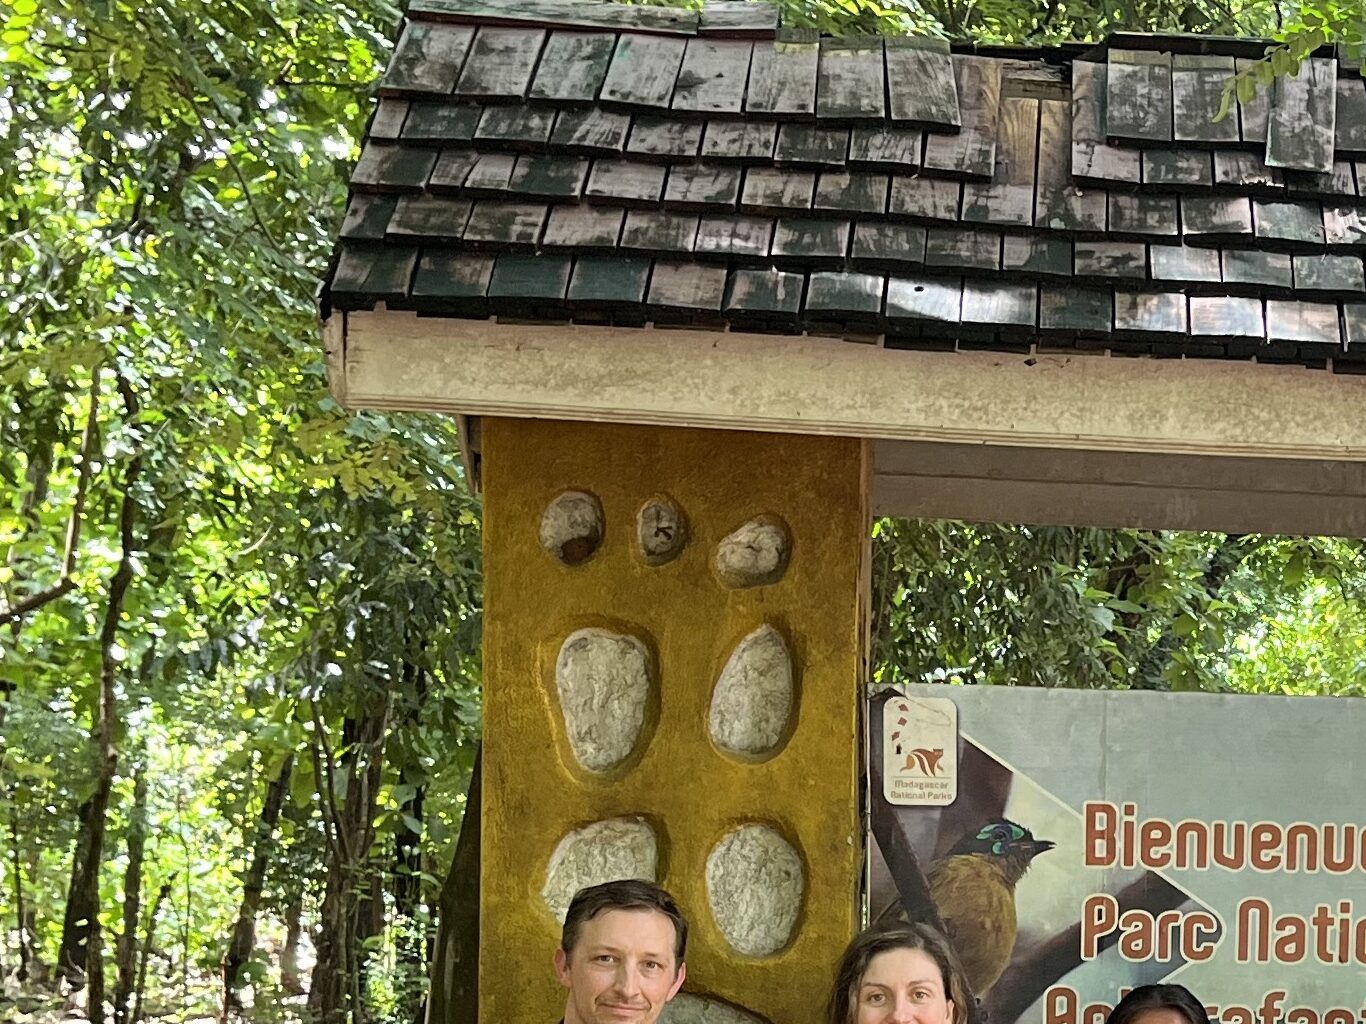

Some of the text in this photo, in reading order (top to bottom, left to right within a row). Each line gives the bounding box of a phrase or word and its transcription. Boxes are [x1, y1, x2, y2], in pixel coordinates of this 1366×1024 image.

[894, 780, 948, 790] Madagascar
[891, 791, 952, 800] National Parks
[1081, 896, 1219, 960] Parc
